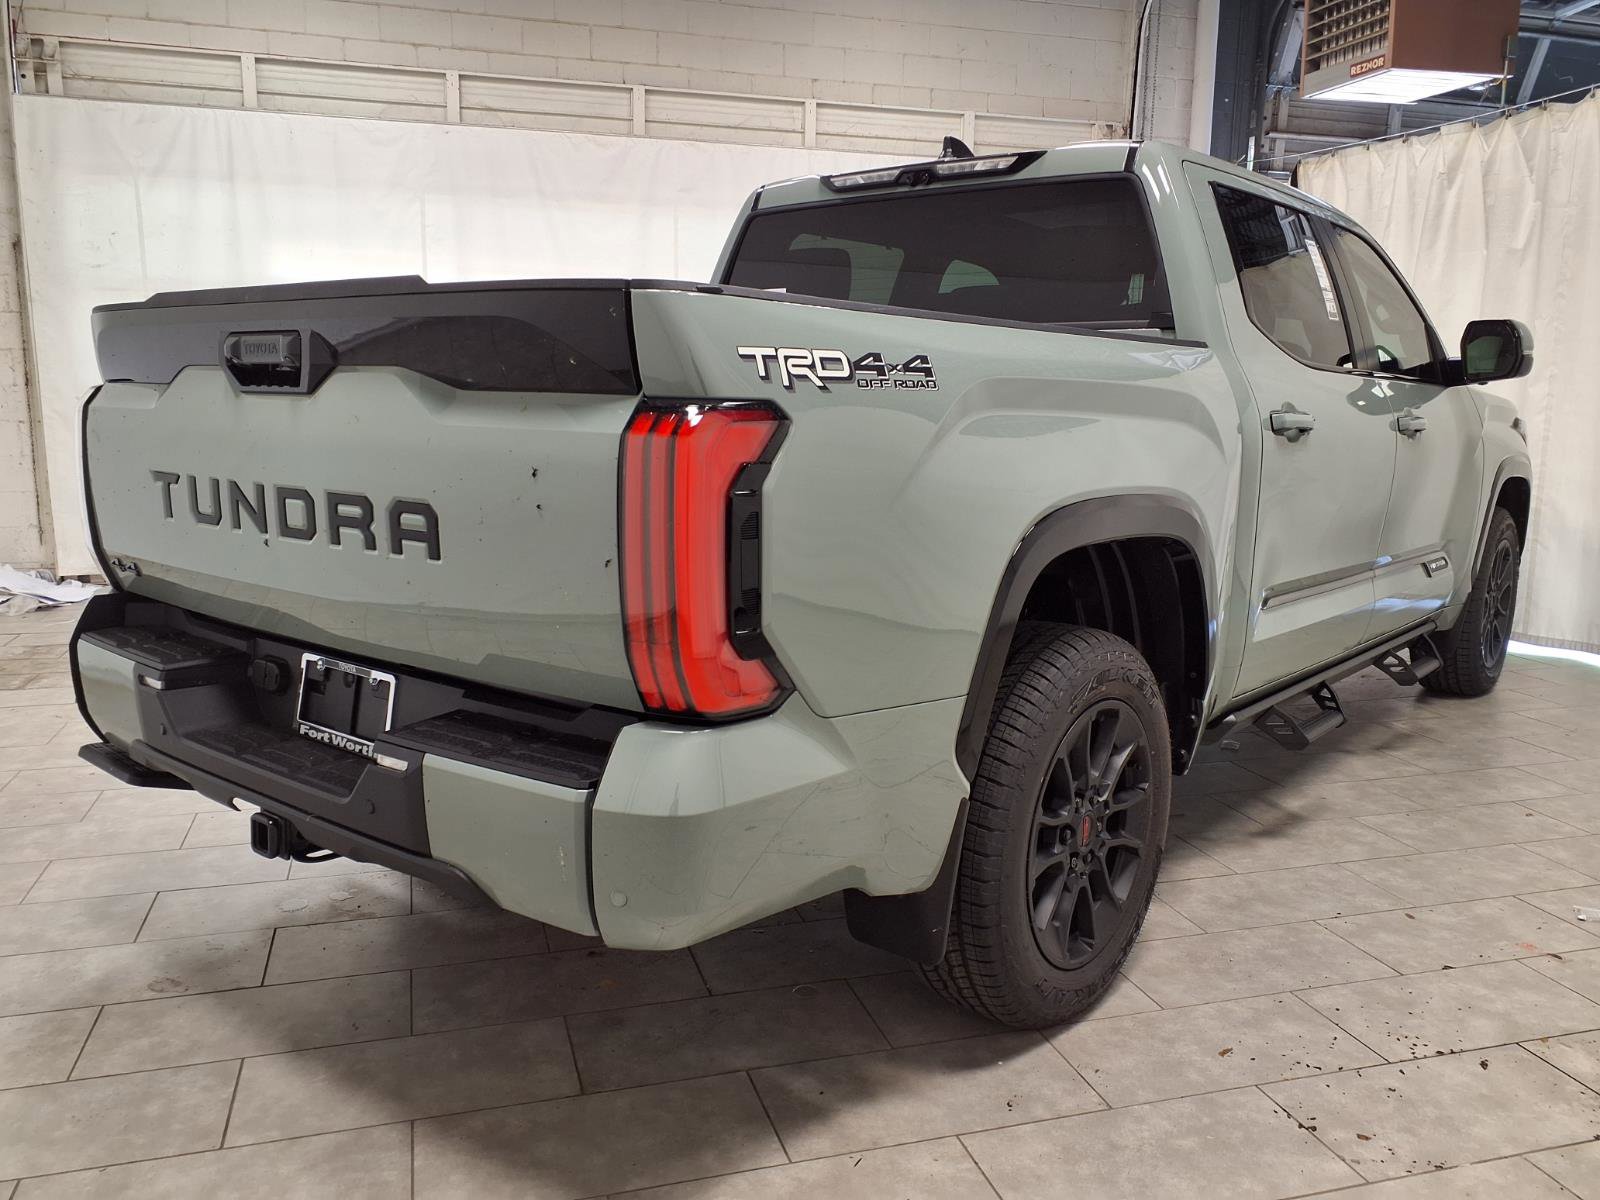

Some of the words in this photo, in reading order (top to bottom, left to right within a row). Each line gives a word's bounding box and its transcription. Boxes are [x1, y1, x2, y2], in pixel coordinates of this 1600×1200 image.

[1350, 57, 1385, 76] REZNOR
[244, 342, 279, 354] TOYOTA
[736, 346, 854, 393] TRD
[853, 352, 936, 379] 4x4
[857, 379, 892, 391] OFF
[894, 379, 939, 391] ROAD
[151, 470, 442, 564] TUNDRA
[299, 724, 330, 743] Fort
